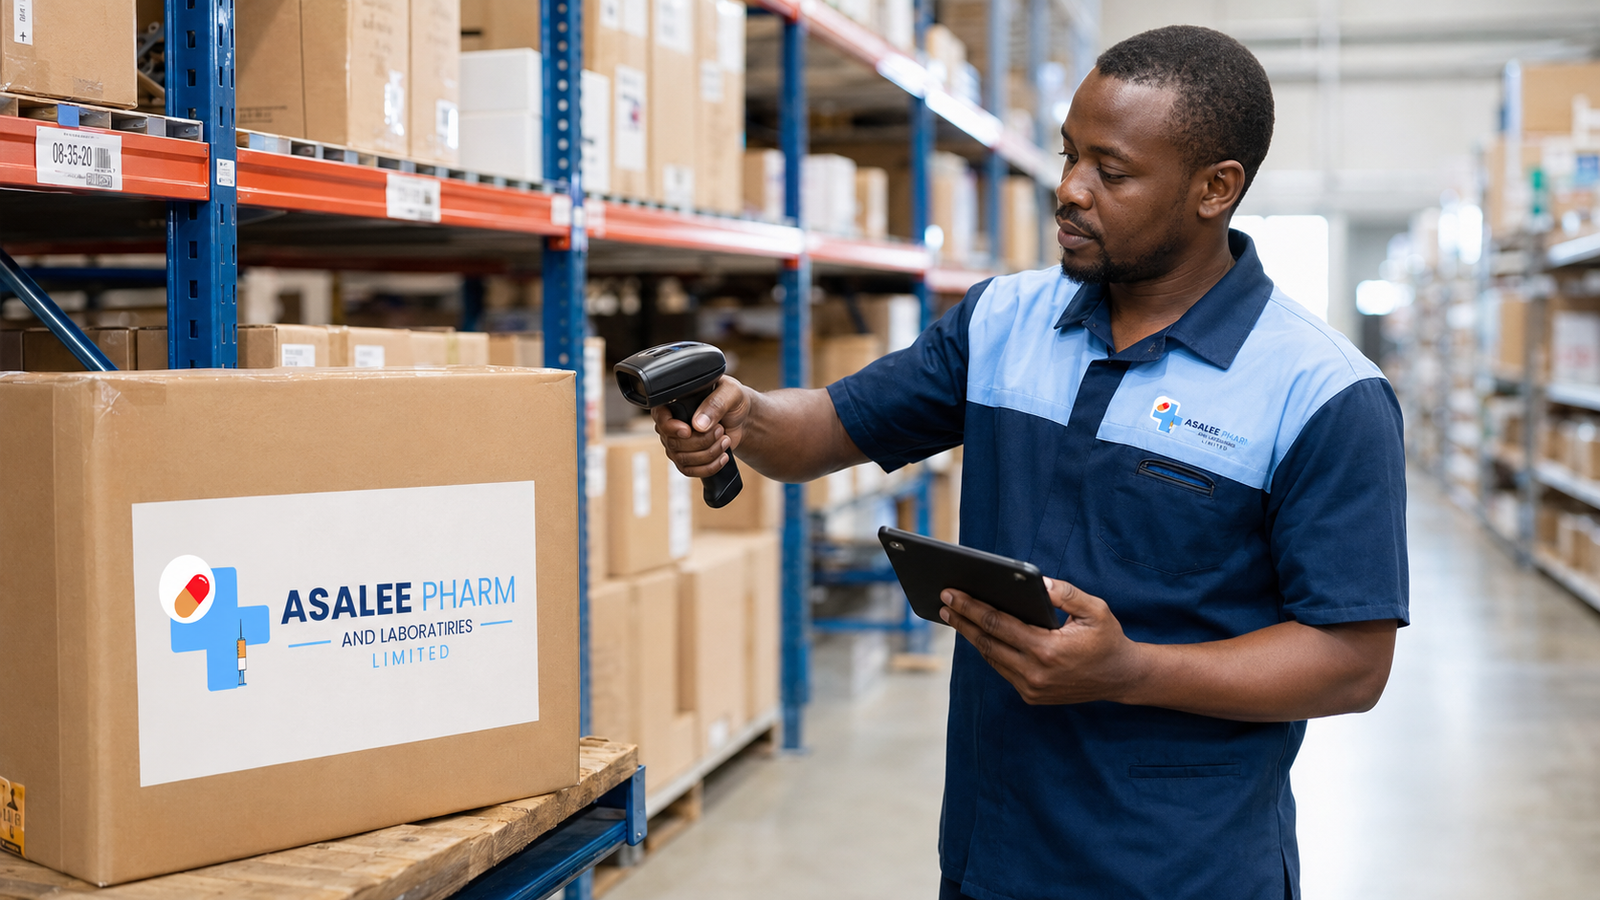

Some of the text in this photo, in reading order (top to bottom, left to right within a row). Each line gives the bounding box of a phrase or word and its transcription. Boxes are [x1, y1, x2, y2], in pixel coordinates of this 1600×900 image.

[1184, 418, 1221, 436] ASALEE
[281, 575, 516, 625] ASALEE PHARM
[341, 618, 474, 648] AND LABORATIRIES
[372, 644, 450, 669] LIMITED
